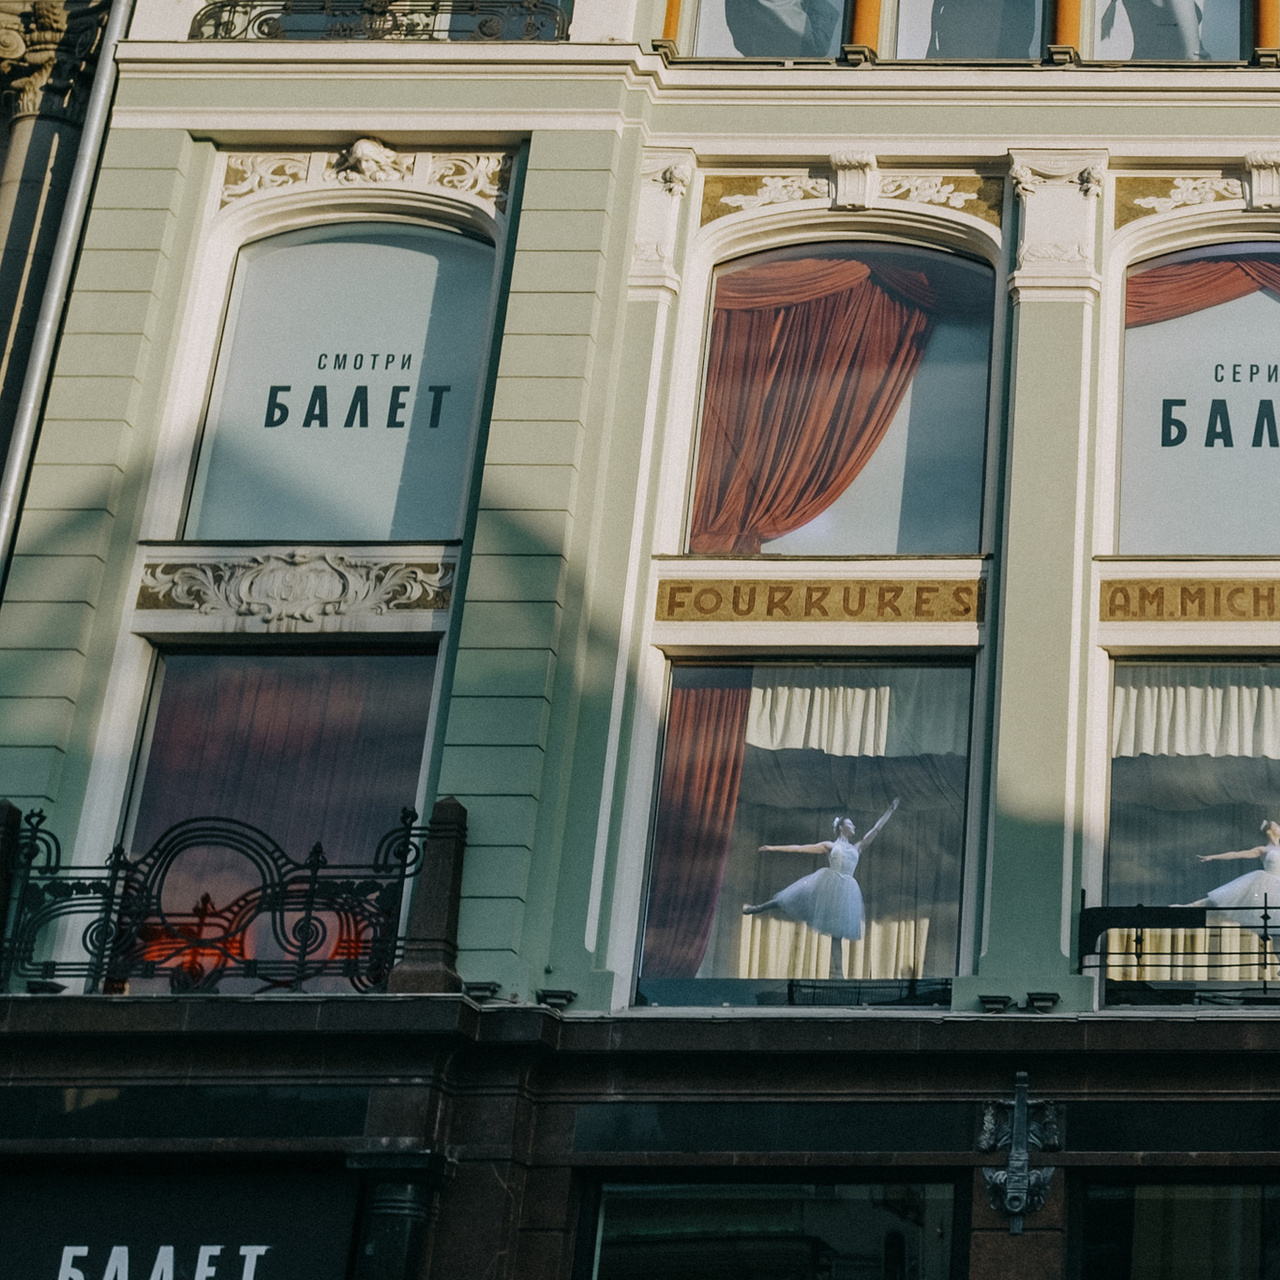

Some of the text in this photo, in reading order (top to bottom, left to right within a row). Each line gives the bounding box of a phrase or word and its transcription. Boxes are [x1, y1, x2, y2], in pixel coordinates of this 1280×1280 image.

[317, 353, 413, 370] СМОТРИ
[264, 385, 451, 428] БАЛЕТ
[667, 586, 974, 617] FOURRURES
